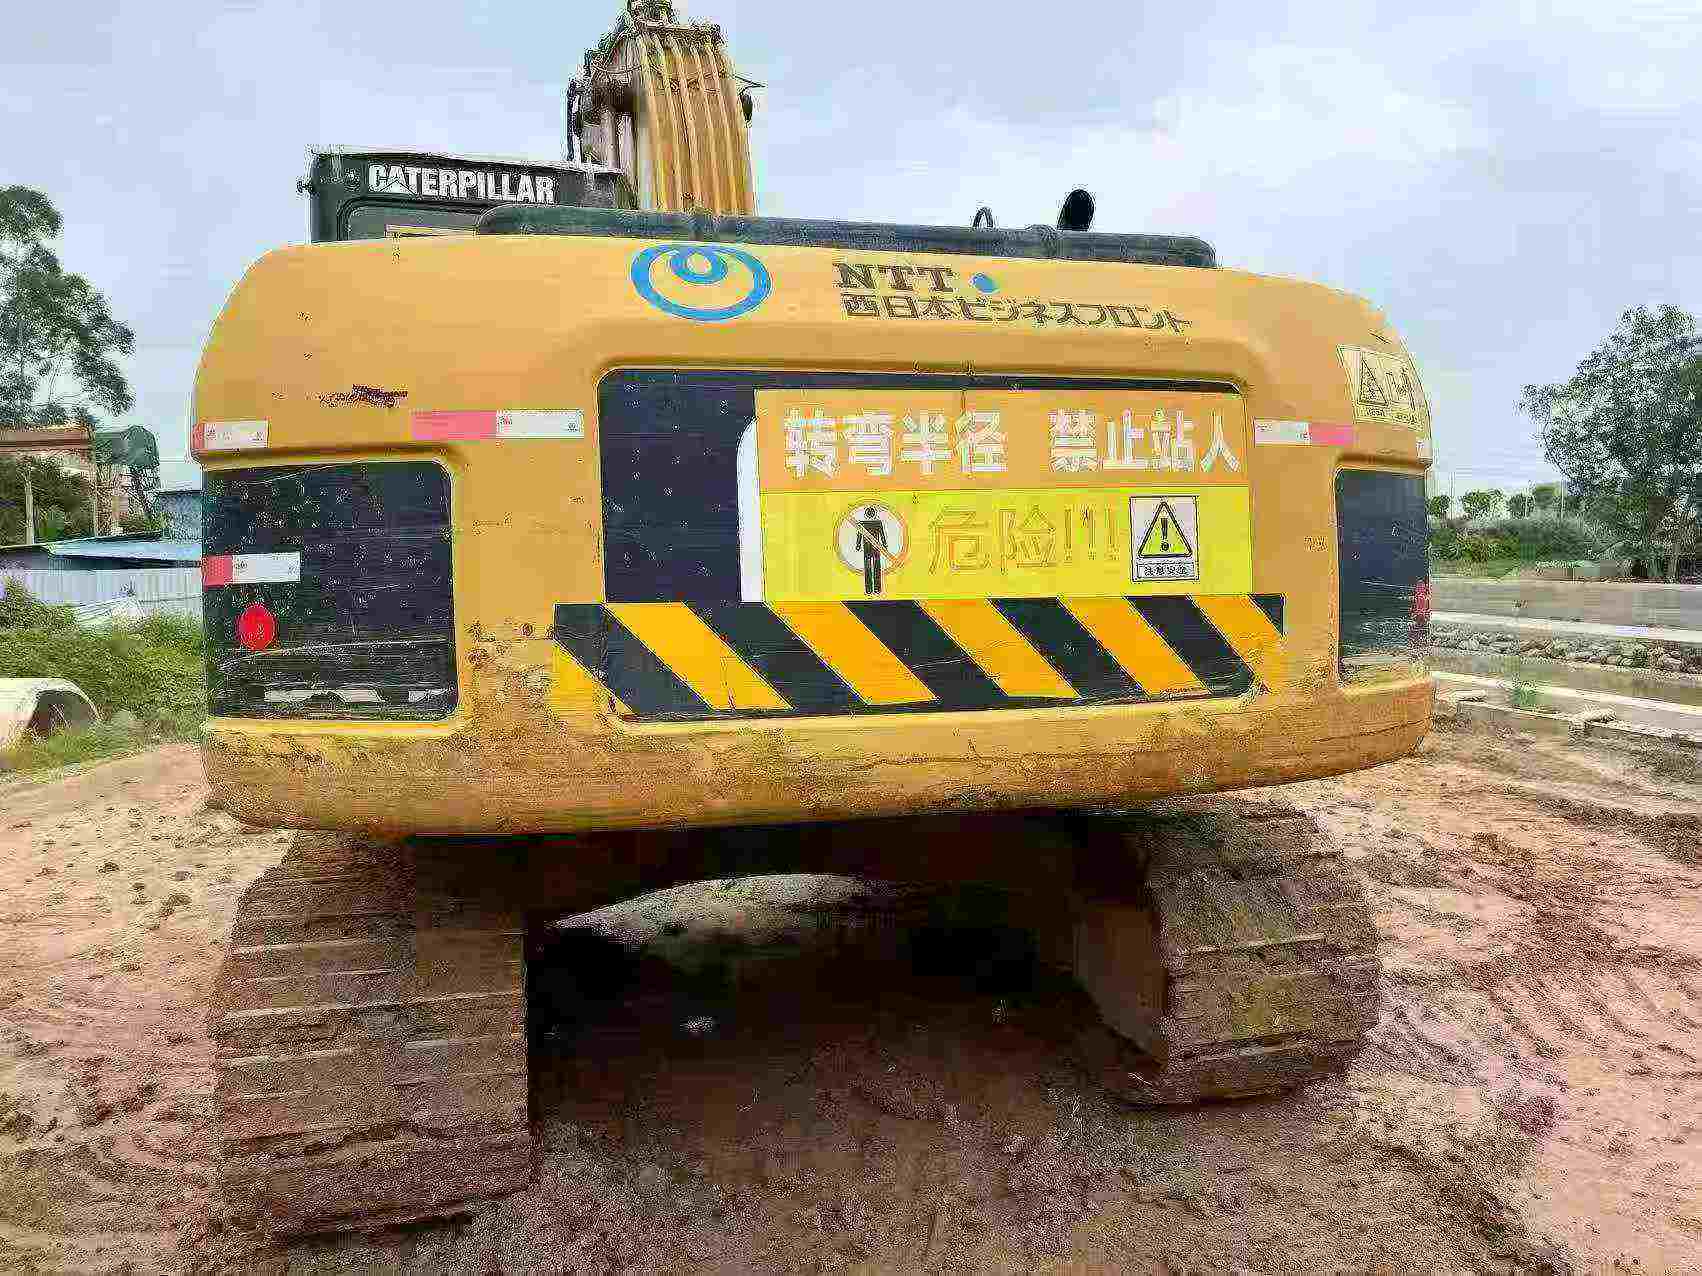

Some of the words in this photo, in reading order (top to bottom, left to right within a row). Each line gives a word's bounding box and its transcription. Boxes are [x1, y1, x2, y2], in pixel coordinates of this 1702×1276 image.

[367, 163, 556, 204] CATERPILLAR
[834, 263, 954, 293] NTT
[841, 294, 1193, 335] 西日本ビジネスフロント
[783, 407, 1008, 479] 转弯半径
[1047, 407, 1241, 474] 禁止站人
